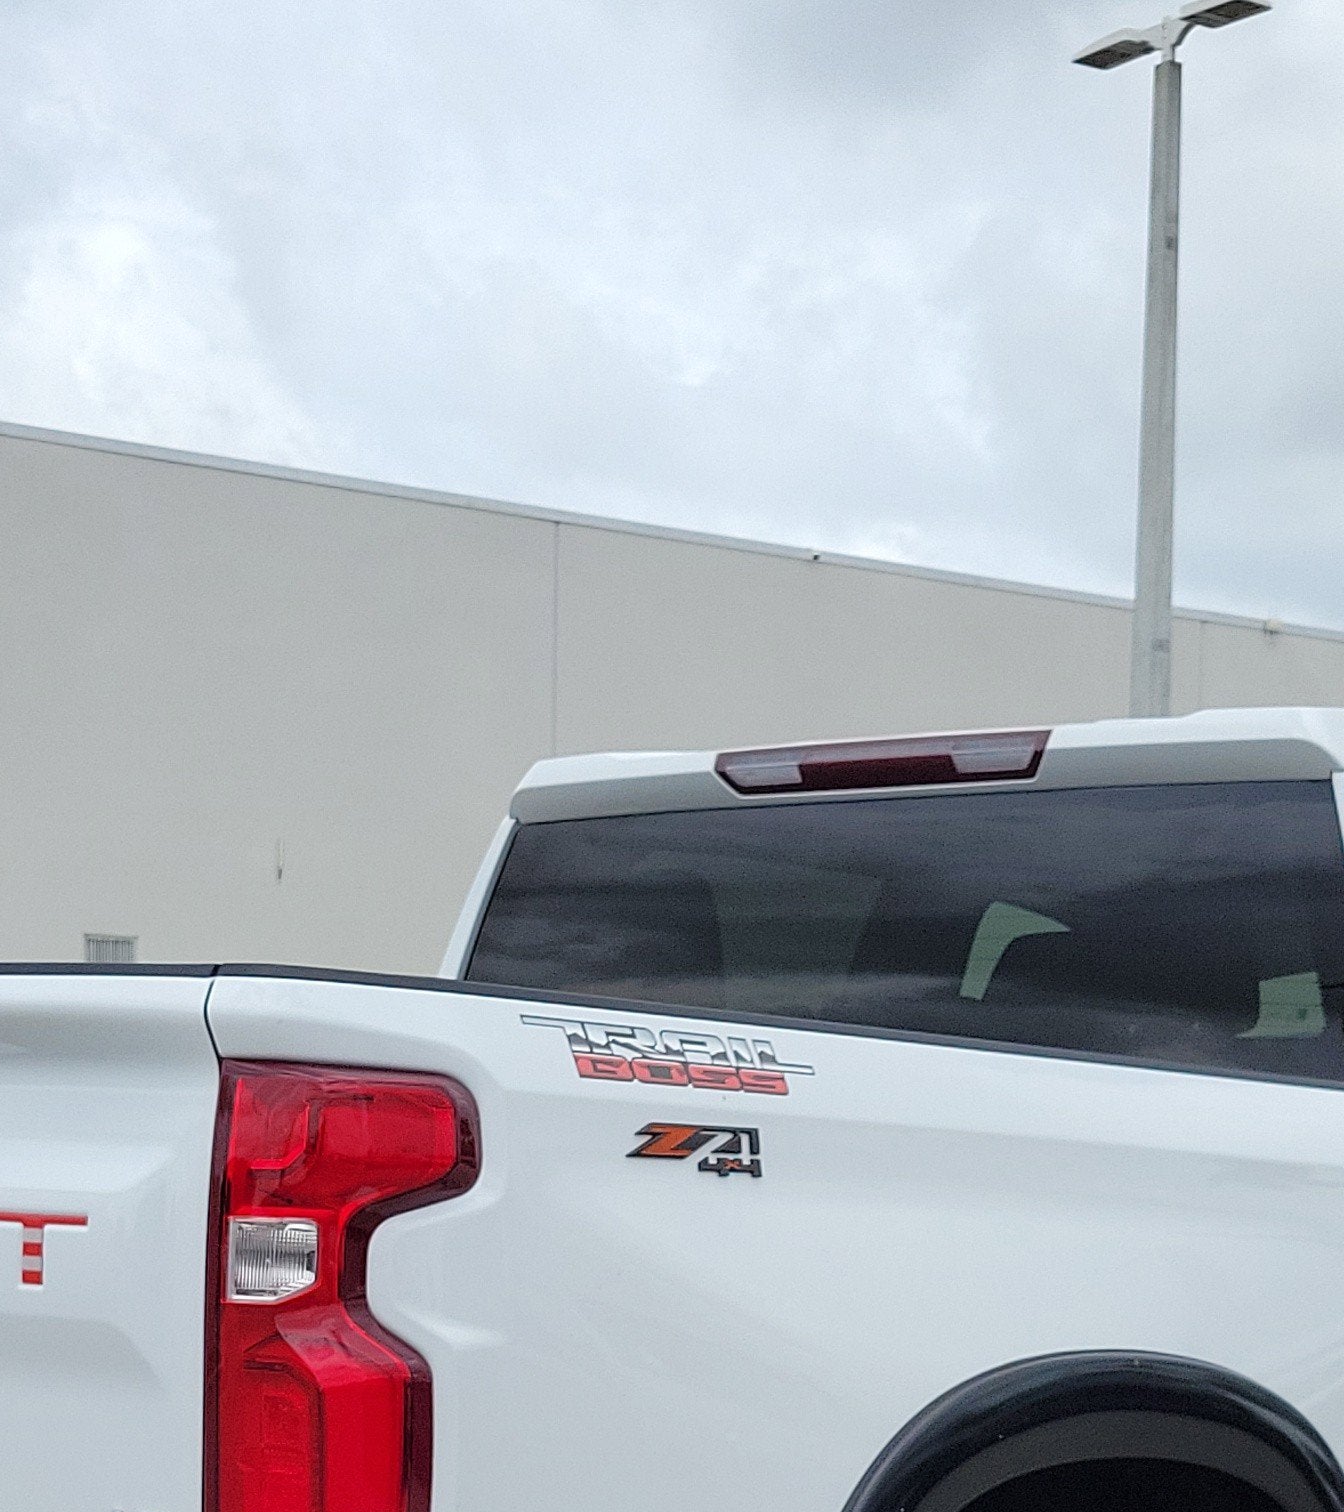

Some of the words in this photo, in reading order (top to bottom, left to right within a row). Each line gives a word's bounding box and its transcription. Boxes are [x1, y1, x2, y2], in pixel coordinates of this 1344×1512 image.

[519, 1013, 815, 1076] TRAIL
[572, 1052, 790, 1096] BOSS
[625, 1121, 762, 1162] Z71
